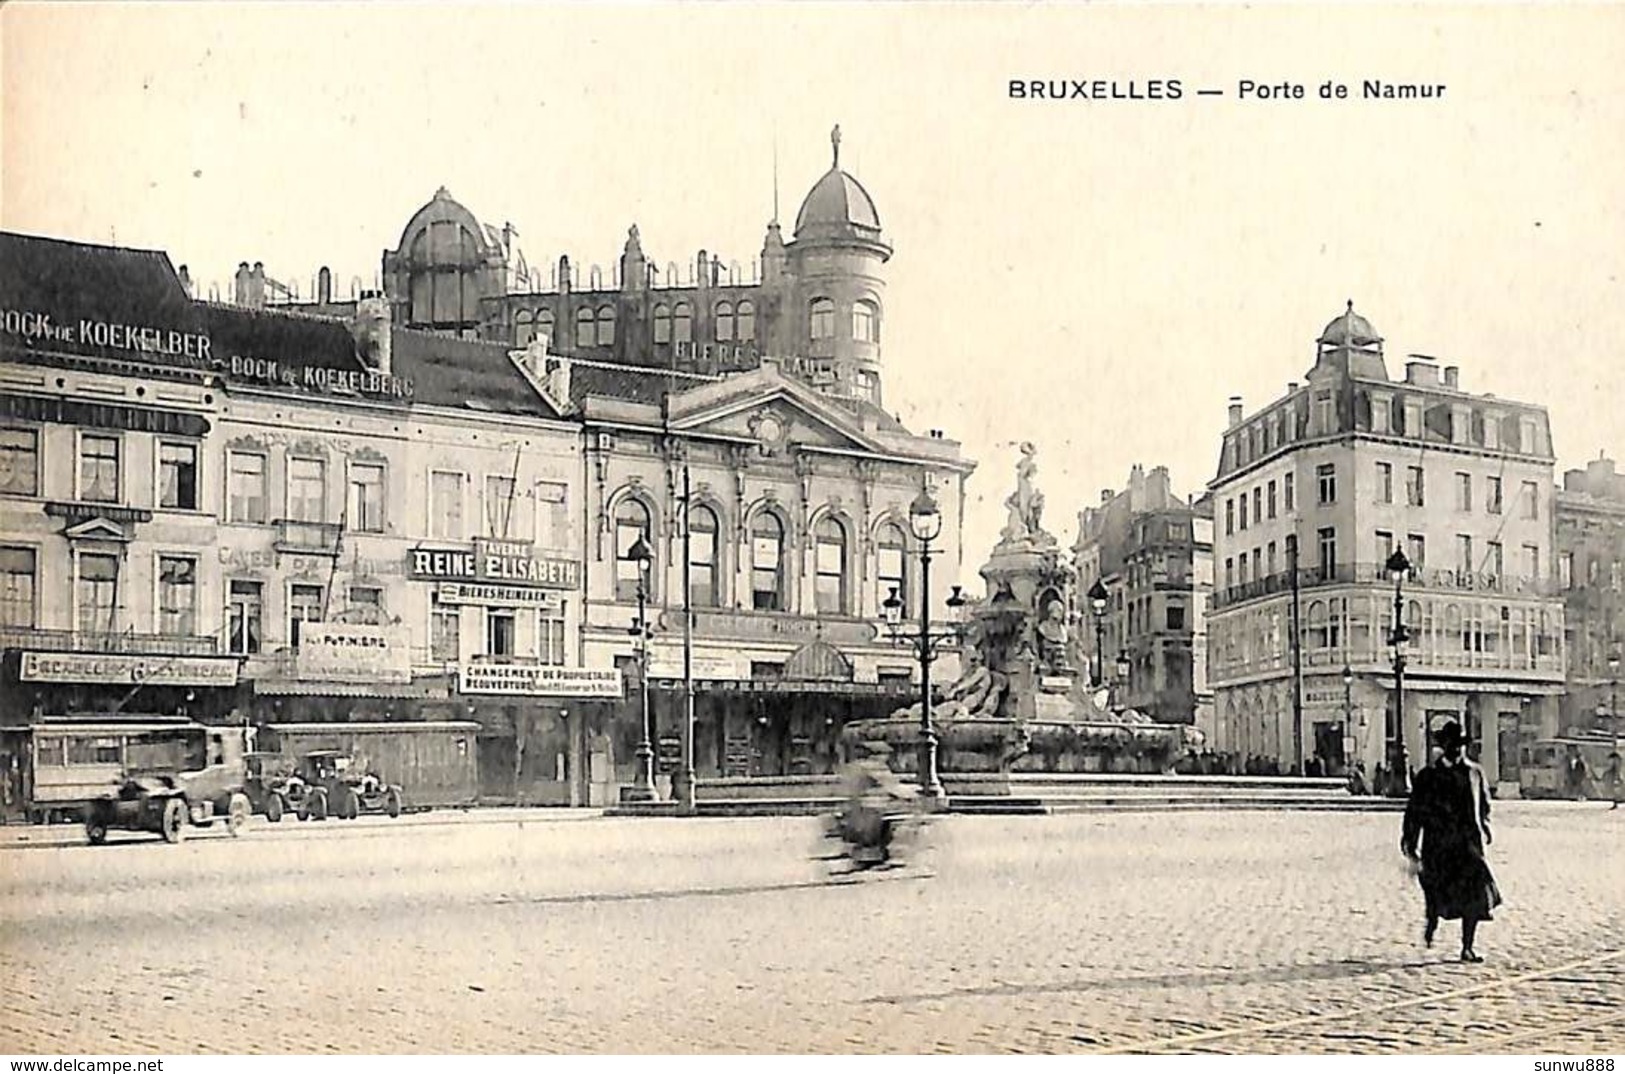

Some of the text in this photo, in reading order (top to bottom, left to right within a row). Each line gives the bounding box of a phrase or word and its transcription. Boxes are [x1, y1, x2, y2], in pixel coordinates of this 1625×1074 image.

[676, 340, 759, 366] BIERES
[231, 355, 277, 380] BOCK
[303, 365, 413, 398] KOEKELBERG
[482, 541, 527, 557] TAVERNE
[414, 551, 475, 576] REINE
[485, 555, 576, 583] ELISABETH
[466, 666, 540, 679] CHANGEMENT
[543, 670, 554, 679] DE
